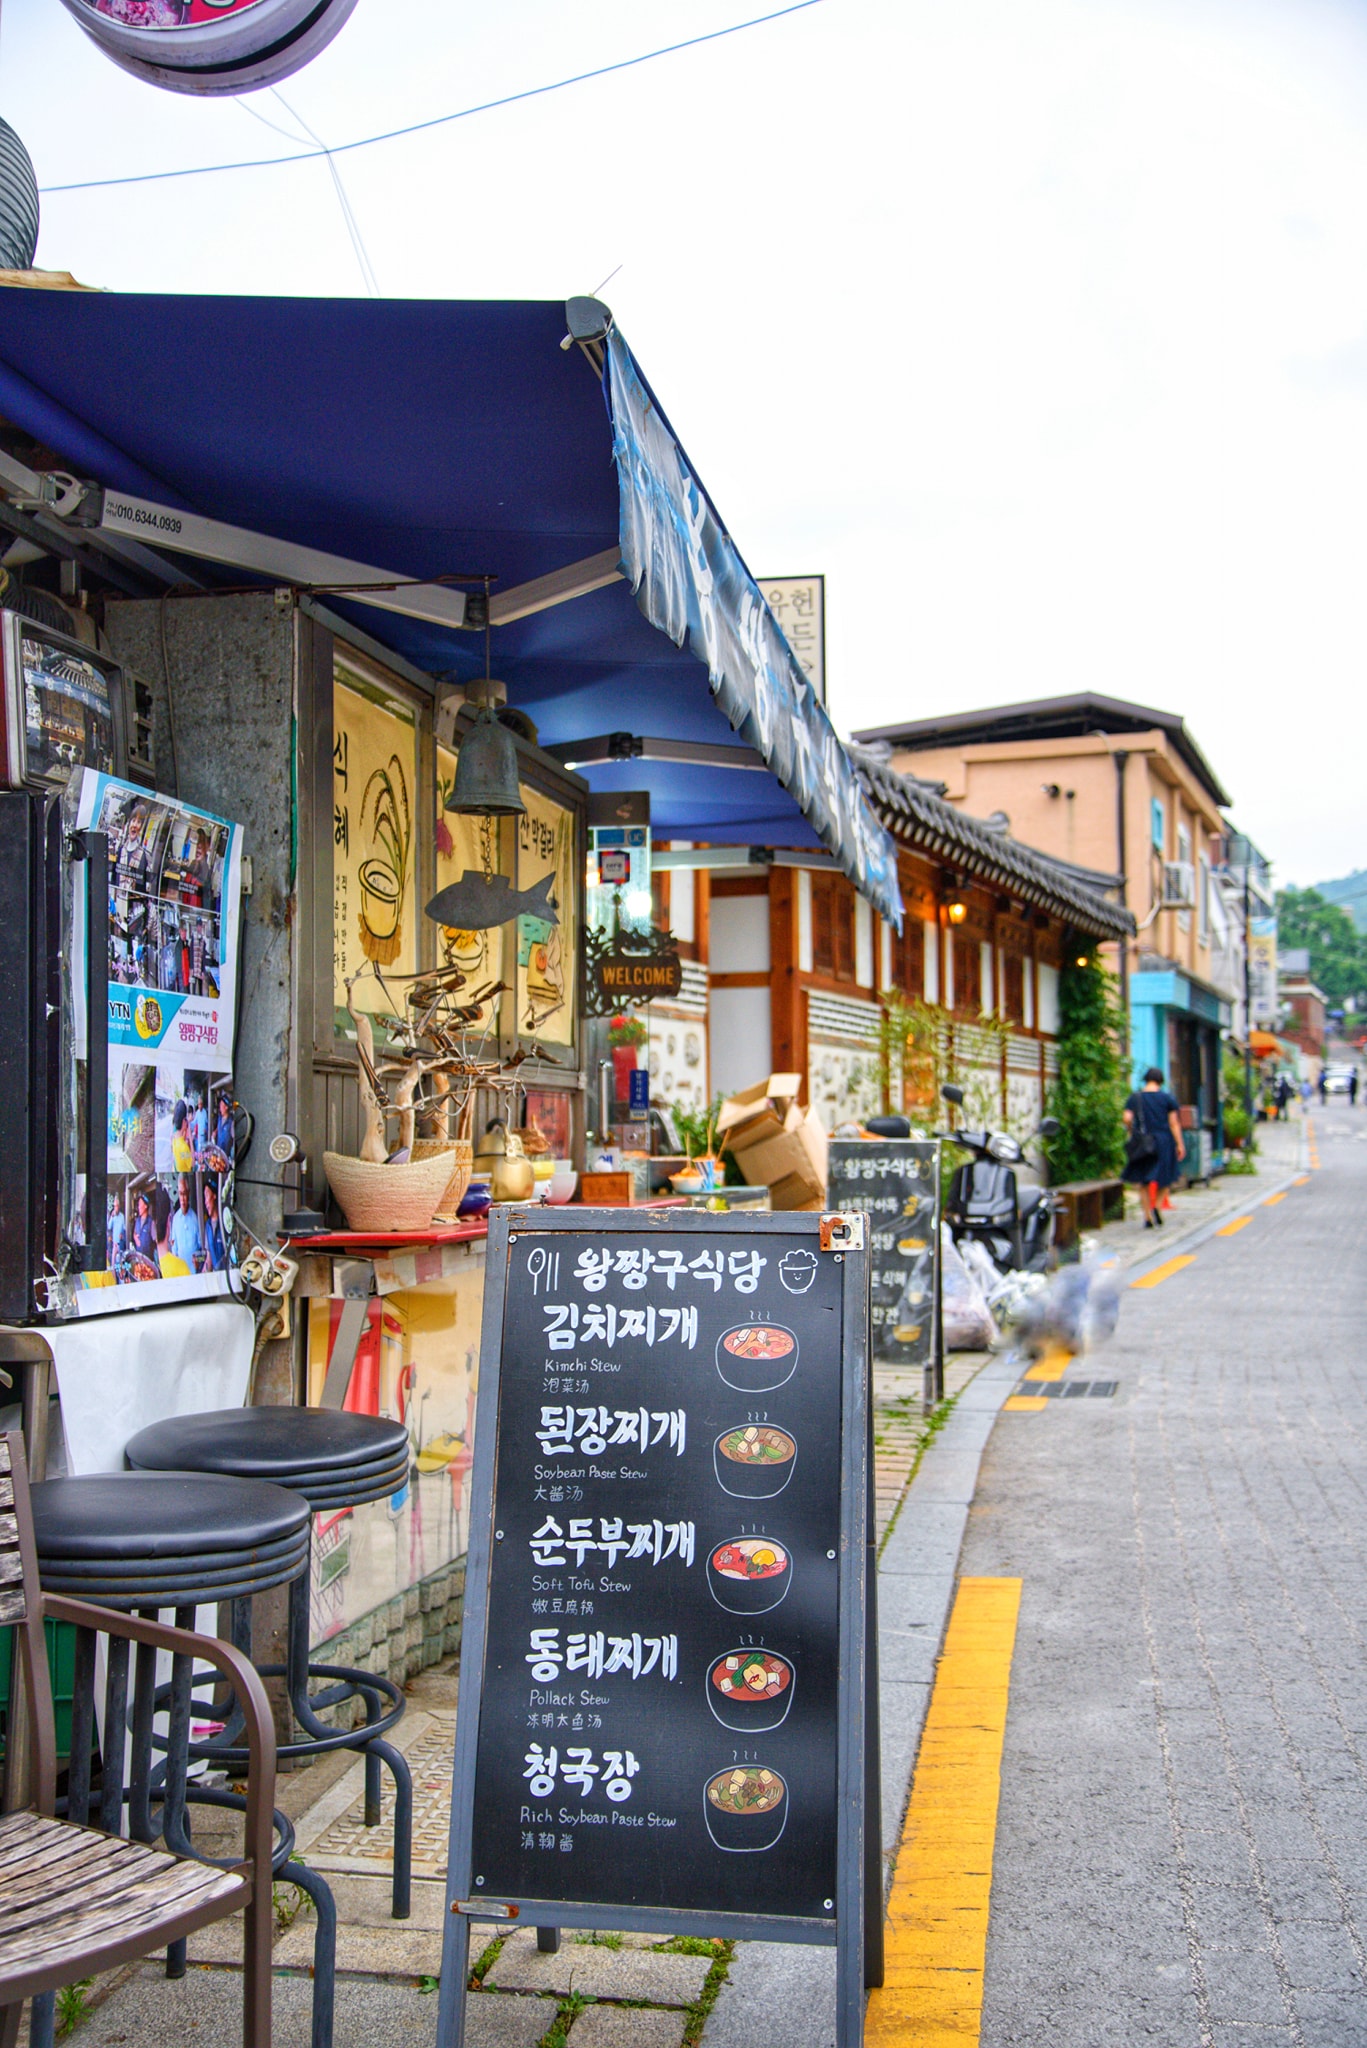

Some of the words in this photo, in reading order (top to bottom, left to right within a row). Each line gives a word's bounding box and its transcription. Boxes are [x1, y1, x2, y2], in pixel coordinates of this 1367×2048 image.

[117, 504, 182, 534] 010.6344.0939
[602, 966, 675, 986] WELCOME
[108, 1002, 131, 1019] YTN
[178, 1021, 219, 1045] 왕짱구식당
[844, 1158, 920, 1180] 왕짱구식당
[573, 1247, 767, 1294] 왕짱구식당
[542, 1302, 698, 1351] 김치찌개
[544, 1357, 587, 1373] Kimchi
[590, 1357, 622, 1373] Stew
[542, 1377, 590, 1395] 泡菜汤
[534, 1405, 687, 1457] 된장찌개
[534, 1464, 586, 1480] Soybean
[588, 1465, 617, 1479] Paste
[619, 1466, 648, 1479] Stew
[529, 1515, 696, 1569] 순두부찌개
[531, 1575, 563, 1592] Soft
[567, 1576, 595, 1591] Tofu
[599, 1576, 632, 1592] Stew
[525, 1628, 678, 1683] 동태찌개
[529, 1689, 575, 1707] Pollack
[580, 1689, 610, 1705] Stew
[522, 1742, 640, 1802] 청국장
[519, 1805, 552, 1824] Rich
[558, 1807, 609, 1827] Soybean
[611, 1810, 644, 1827] Paste
[647, 1812, 677, 1828] Stew
